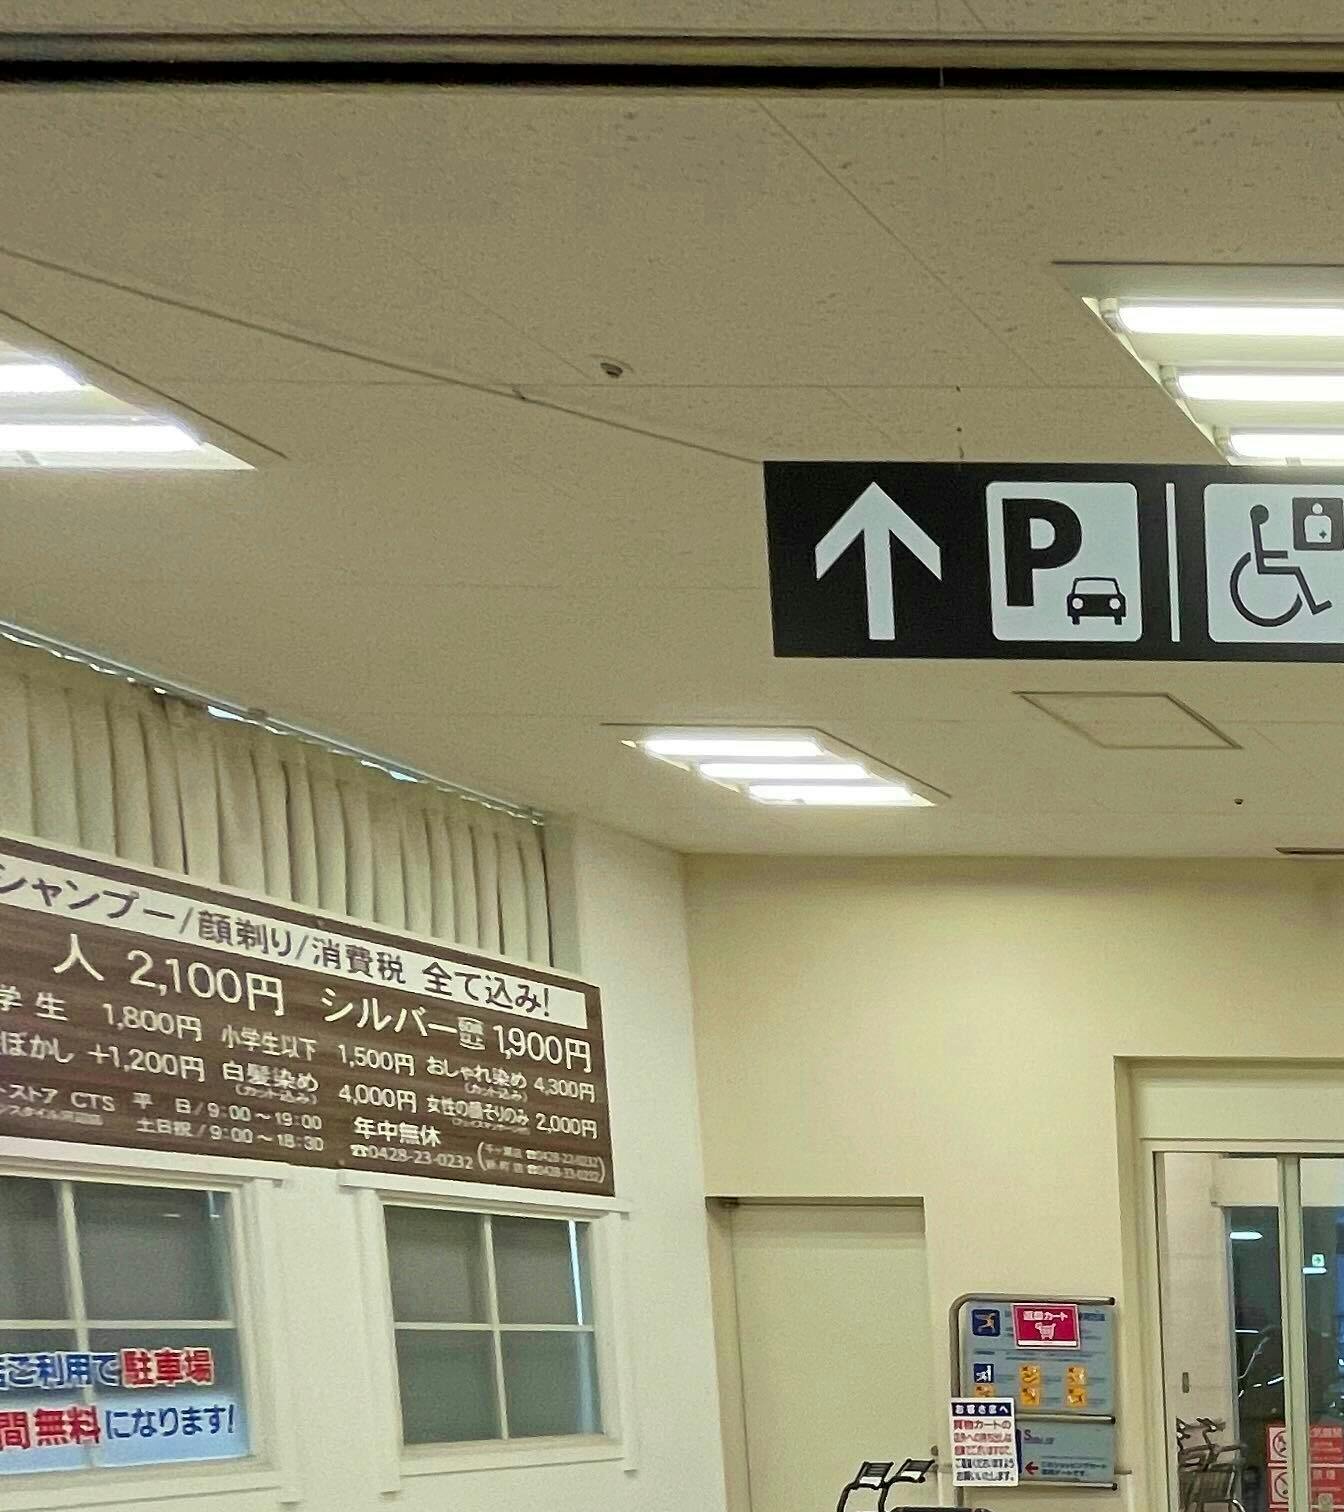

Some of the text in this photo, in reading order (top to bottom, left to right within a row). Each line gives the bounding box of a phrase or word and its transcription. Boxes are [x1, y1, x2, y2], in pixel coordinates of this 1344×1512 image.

[1002, 497, 1083, 608] P
[127, 949, 285, 1017] 2,100円
[493, 1024, 592, 1073] 1,900円
[103, 1003, 202, 1042] 1,800円
[338, 1044, 415, 1076] 1,500円
[533, 1076, 596, 1104] 4,300円
[70, 1091, 116, 1112] CTS
[338, 1084, 417, 1113] 4,000円
[535, 1112, 598, 1140] 2,000円
[353, 1115, 442, 1148] 年中無休
